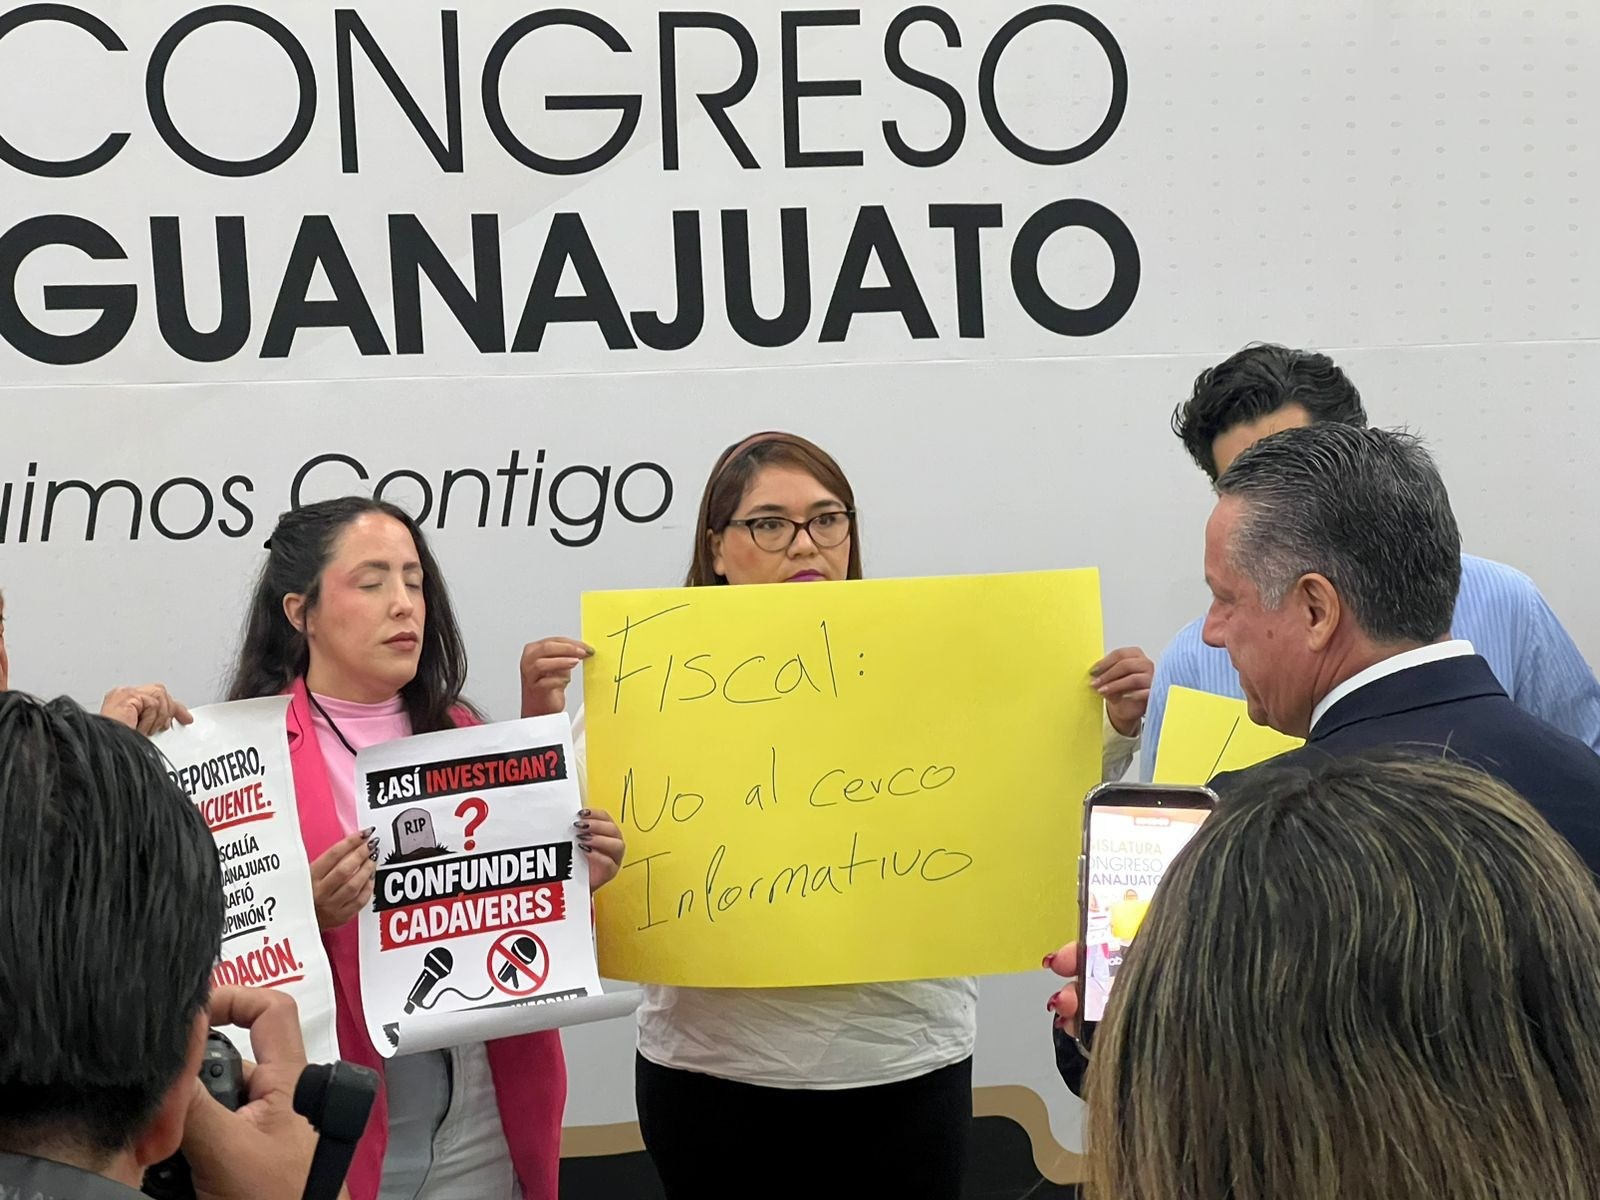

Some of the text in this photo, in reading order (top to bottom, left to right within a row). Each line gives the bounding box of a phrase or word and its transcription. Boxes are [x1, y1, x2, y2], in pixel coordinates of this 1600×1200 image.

[0, 3, 1129, 178] CONGRESO
[0, 198, 1141, 365] GUANAJUATO
[290, 449, 673, 547] Contigo
[376, 750, 558, 805] ¿ASÍ INVESTIGAN?
[620, 767, 704, 833] No
[744, 747, 778, 810] al
[403, 817, 427, 835] RIP
[1092, 839, 1162, 855] ISLATURA
[383, 847, 557, 904] CONFUNDEN
[622, 832, 973, 931] Informativo
[388, 887, 553, 944] CADÁVERES
